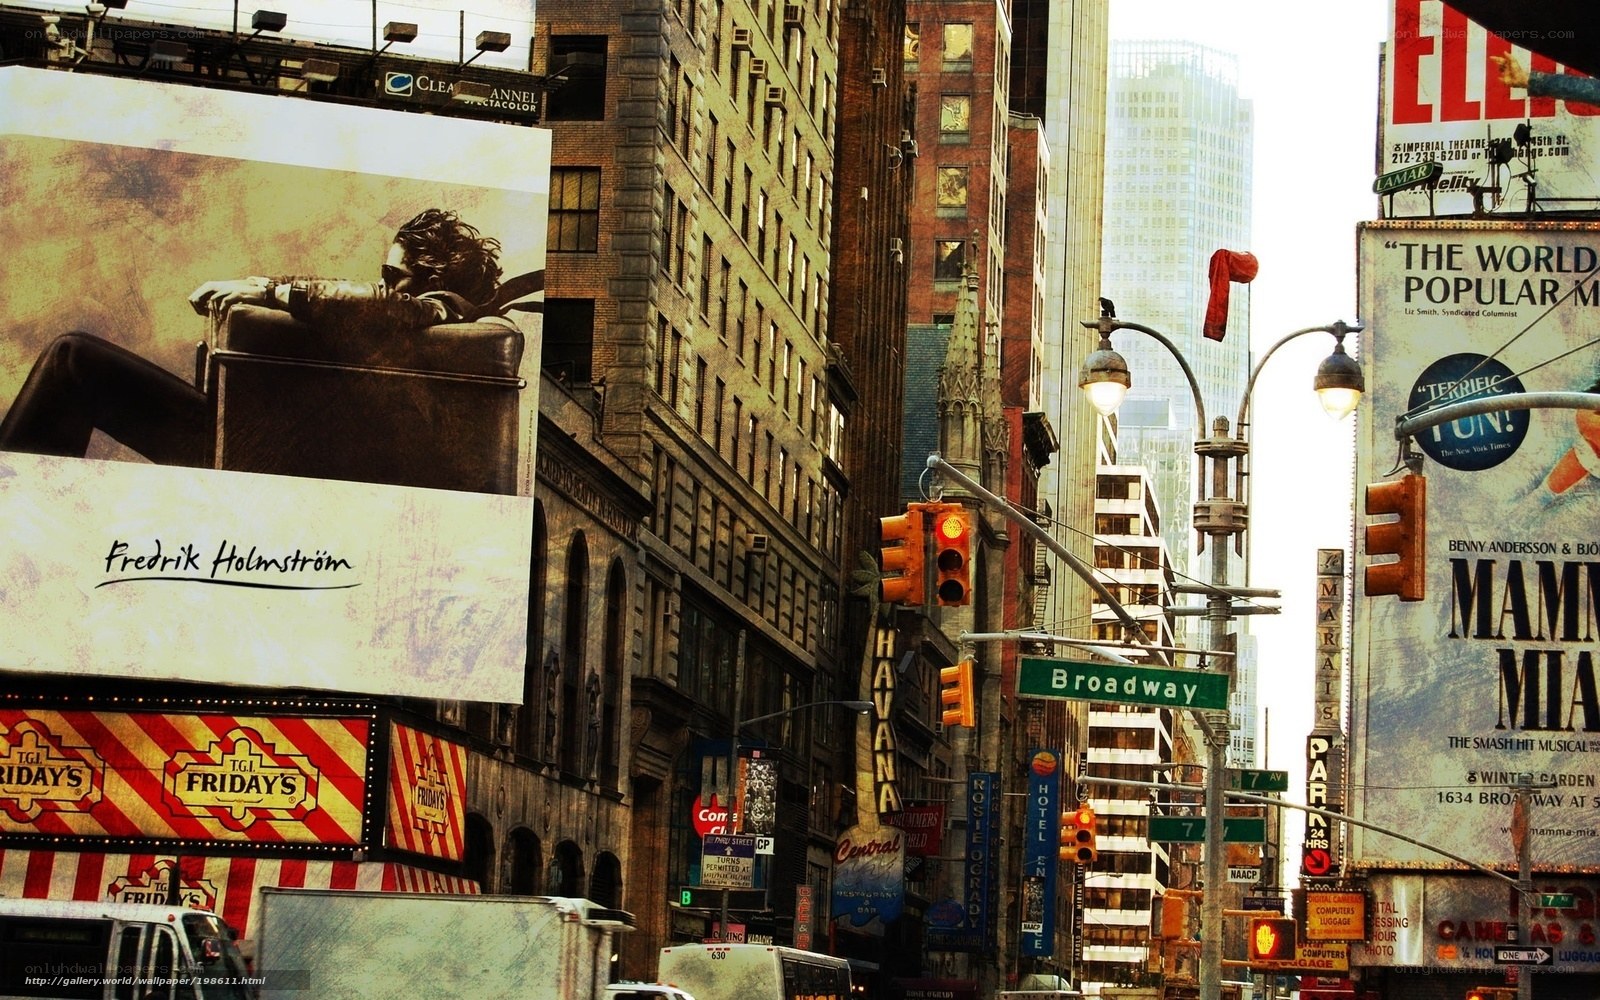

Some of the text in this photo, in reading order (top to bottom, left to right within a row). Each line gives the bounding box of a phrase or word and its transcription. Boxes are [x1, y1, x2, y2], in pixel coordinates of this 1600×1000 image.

[1403, 141, 1444, 152] IMPERIAL
[1449, 138, 1486, 149] THEATRE
[1556, 135, 1570, 146] St.
[1392, 149, 1468, 164] 212-239-6200
[1472, 152, 1481, 160] or
[1376, 165, 1428, 191] LAMAR
[1476, 244, 1598, 273] WORLD
[1404, 276, 1560, 306] POPULAR
[1441, 441, 1511, 457] The New York Times
[1449, 540, 1487, 552] BENNY
[1488, 541, 1557, 554] ANDERSSON
[1561, 543, 1572, 555] &
[105, 539, 355, 578] Fredrik Holmström
[1051, 668, 1198, 705] Broadway
[873, 629, 899, 814] HAVANA
[1448, 736, 1589, 752] THE SMASH HIT MUSICAL
[229, 759, 256, 773] T.G.I.
[187, 772, 297, 796] FRIDAY'S
[1248, 772, 1282, 788] 7 AV
[1309, 738, 1329, 828] PARK
[1437, 792, 1474, 804] 1634
[1479, 792, 1564, 808] BROAWAY
[1570, 795, 1587, 808] AT
[1037, 784, 1049, 842] HOTEL
[1181, 822, 1194, 837] 7
[1310, 828, 1325, 838] 24
[836, 833, 902, 864] Central
[1306, 839, 1329, 849] HRS
[706, 864, 740, 873] PERMITTED
[1229, 870, 1258, 880] NAACP
[1546, 895, 1554, 906] 7
[1316, 906, 1355, 915] COMPUTERS
[1320, 918, 1351, 926] LUGGAGE
[711, 951, 726, 960] 630
[1302, 948, 1345, 959] COMPUTERS
[1364, 946, 1394, 956] PHOTO
[1502, 951, 1545, 960] ONE WAY
